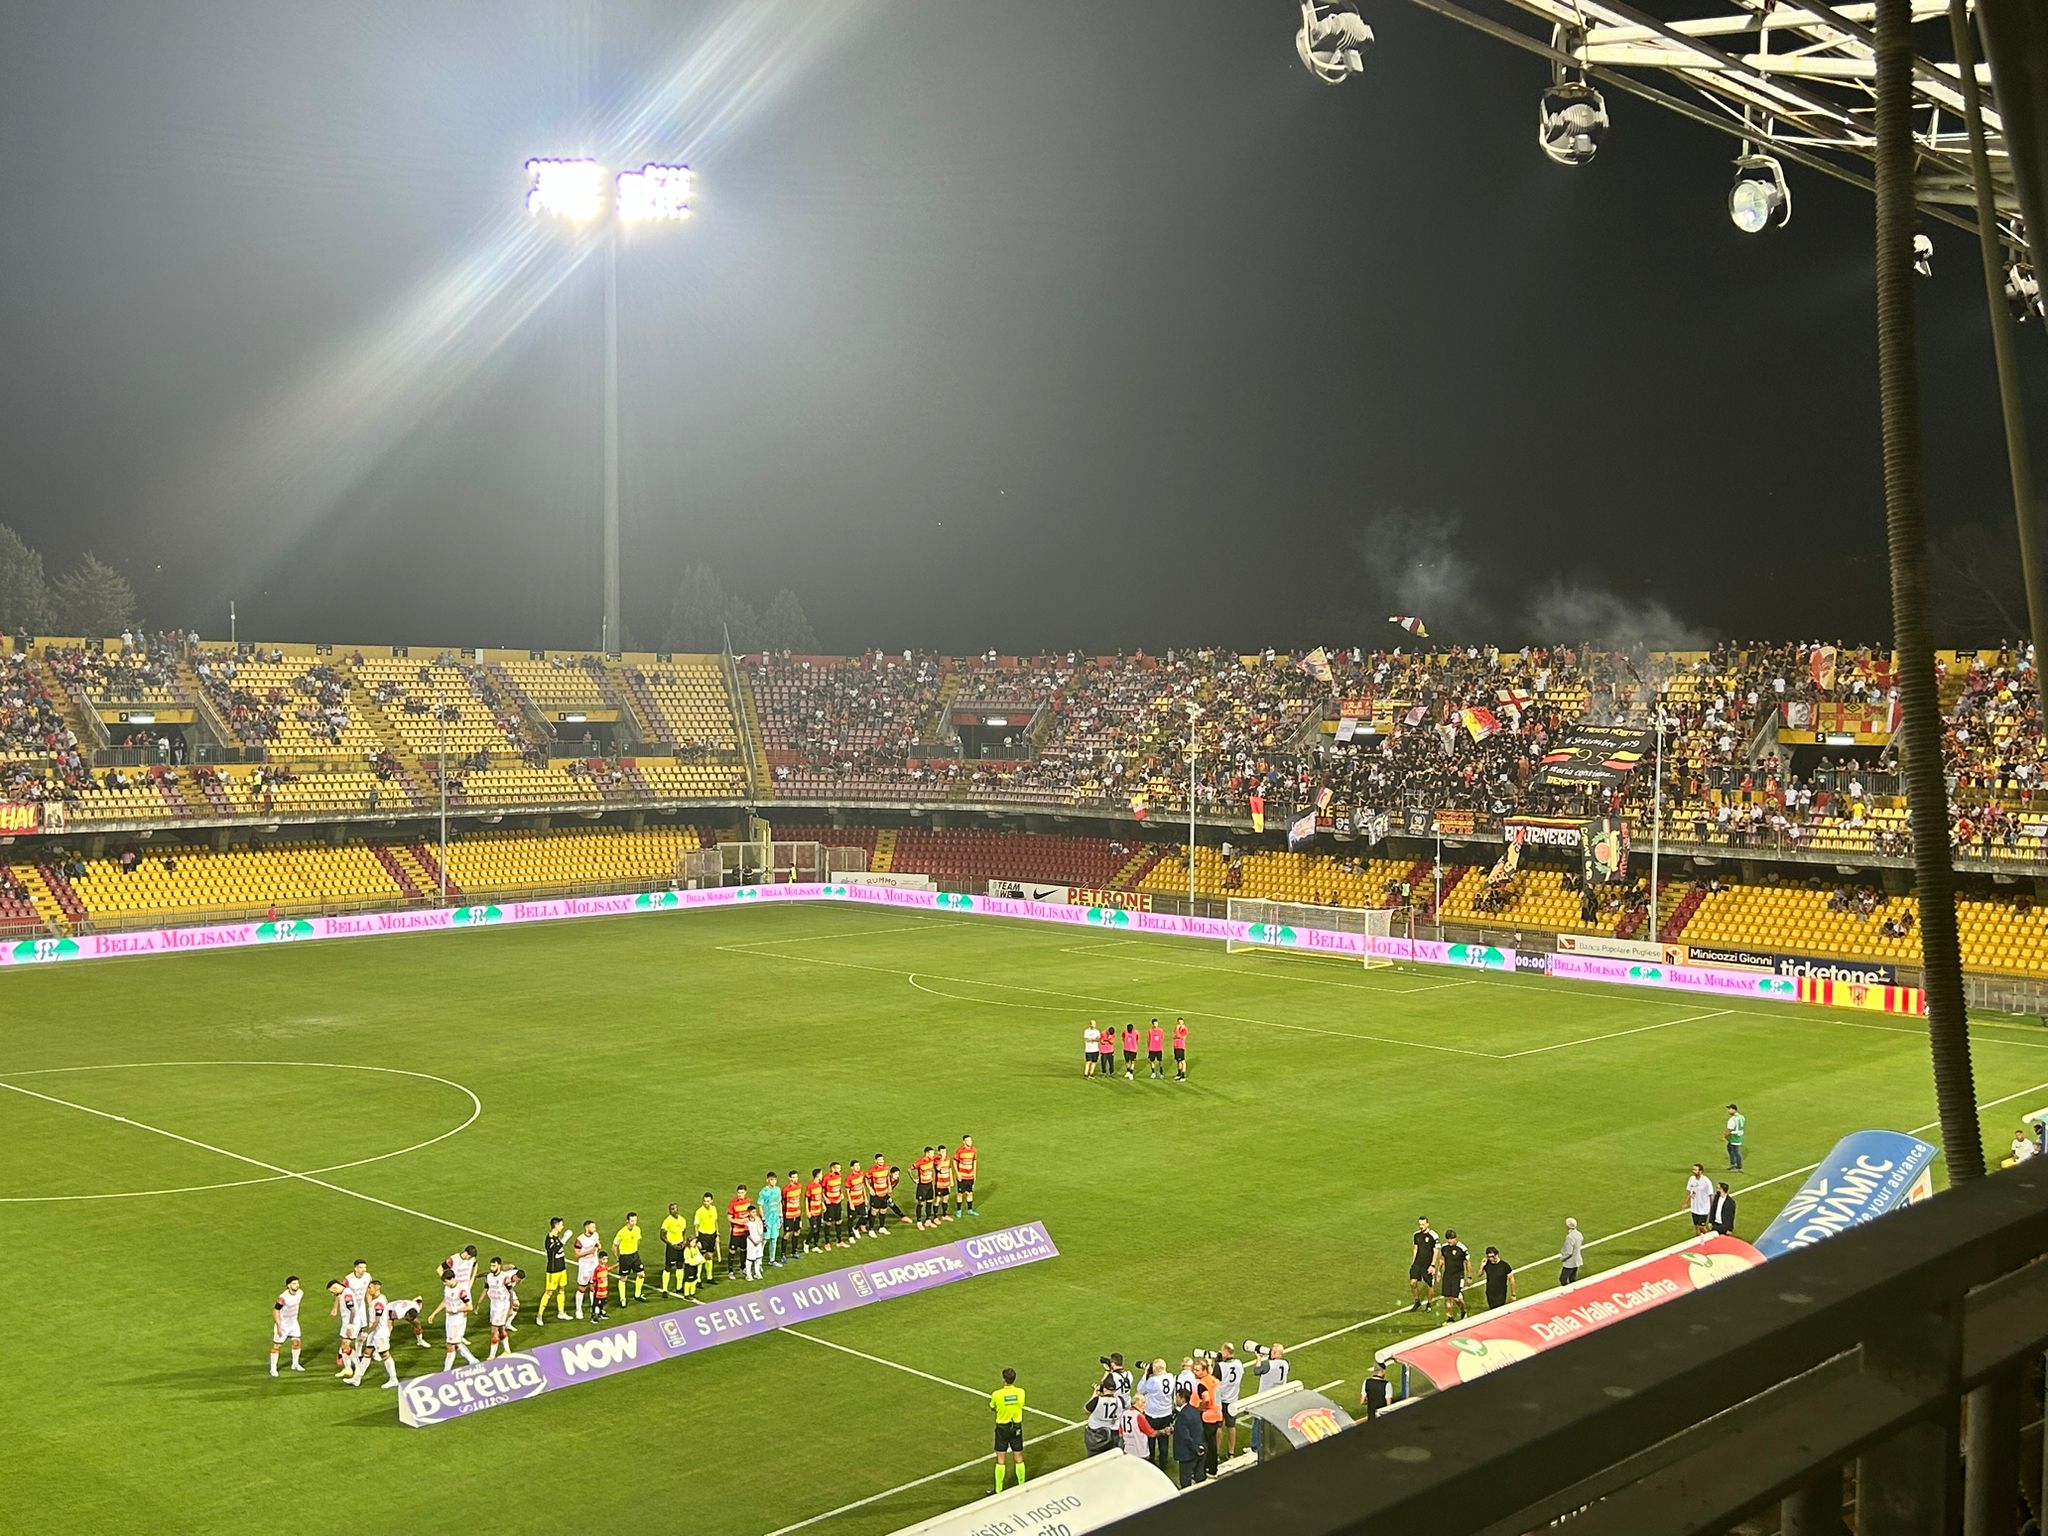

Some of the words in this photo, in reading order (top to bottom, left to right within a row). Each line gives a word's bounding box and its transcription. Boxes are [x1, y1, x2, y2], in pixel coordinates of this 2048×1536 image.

[1575, 748, 1612, 766] 95
[866, 876, 897, 887] RUMMO
[849, 885, 880, 900] BELLA
[884, 888, 932, 905] MOLISANA
[1067, 887, 1151, 913] PETRONE
[514, 904, 559, 919] BELLA
[982, 897, 1022, 917] BELLA
[325, 919, 373, 934] BELLA
[1138, 913, 1177, 931] BELLA
[95, 935, 154, 954] BELLA
[1308, 929, 1356, 951] BELLA
[1601, 944, 1631, 956] Popolare
[1632, 947, 1661, 960] Pugliese
[1690, 948, 1738, 962] Minicozzi
[1738, 953, 1773, 966] Gianni
[1515, 955, 1546, 969] 00:00
[1554, 957, 1581, 973] BELLA
[1780, 958, 1879, 984] ticketone
[1670, 970, 1701, 984] BELLA
[1868, 1186, 1893, 1216] your
[1888, 1143, 1927, 1188] advance
[966, 1226, 1045, 1259] CATTOLICA
[976, 1244, 1051, 1271] ASSICURAZIONI
[694, 1302, 765, 1336] SERIE
[769, 1296, 787, 1316] C
[797, 1281, 842, 1310] NOW
[1530, 1315, 1583, 1342] Dalla
[1578, 1297, 1620, 1325] Valle
[1612, 1276, 1680, 1309] Caudina
[560, 1329, 638, 1376] NOW
[451, 1362, 487, 1380] Fratelli
[1229, 1366, 1237, 1383] 3
[407, 1361, 543, 1419] Beretta
[1161, 1378, 1170, 1395] 8
[1103, 1402, 1118, 1419] 12
[1122, 1415, 1133, 1433] 13
[971, 1520, 1017, 1536] sita
[1008, 1513, 1029, 1529] il
[1026, 1495, 1082, 1524] nostro
